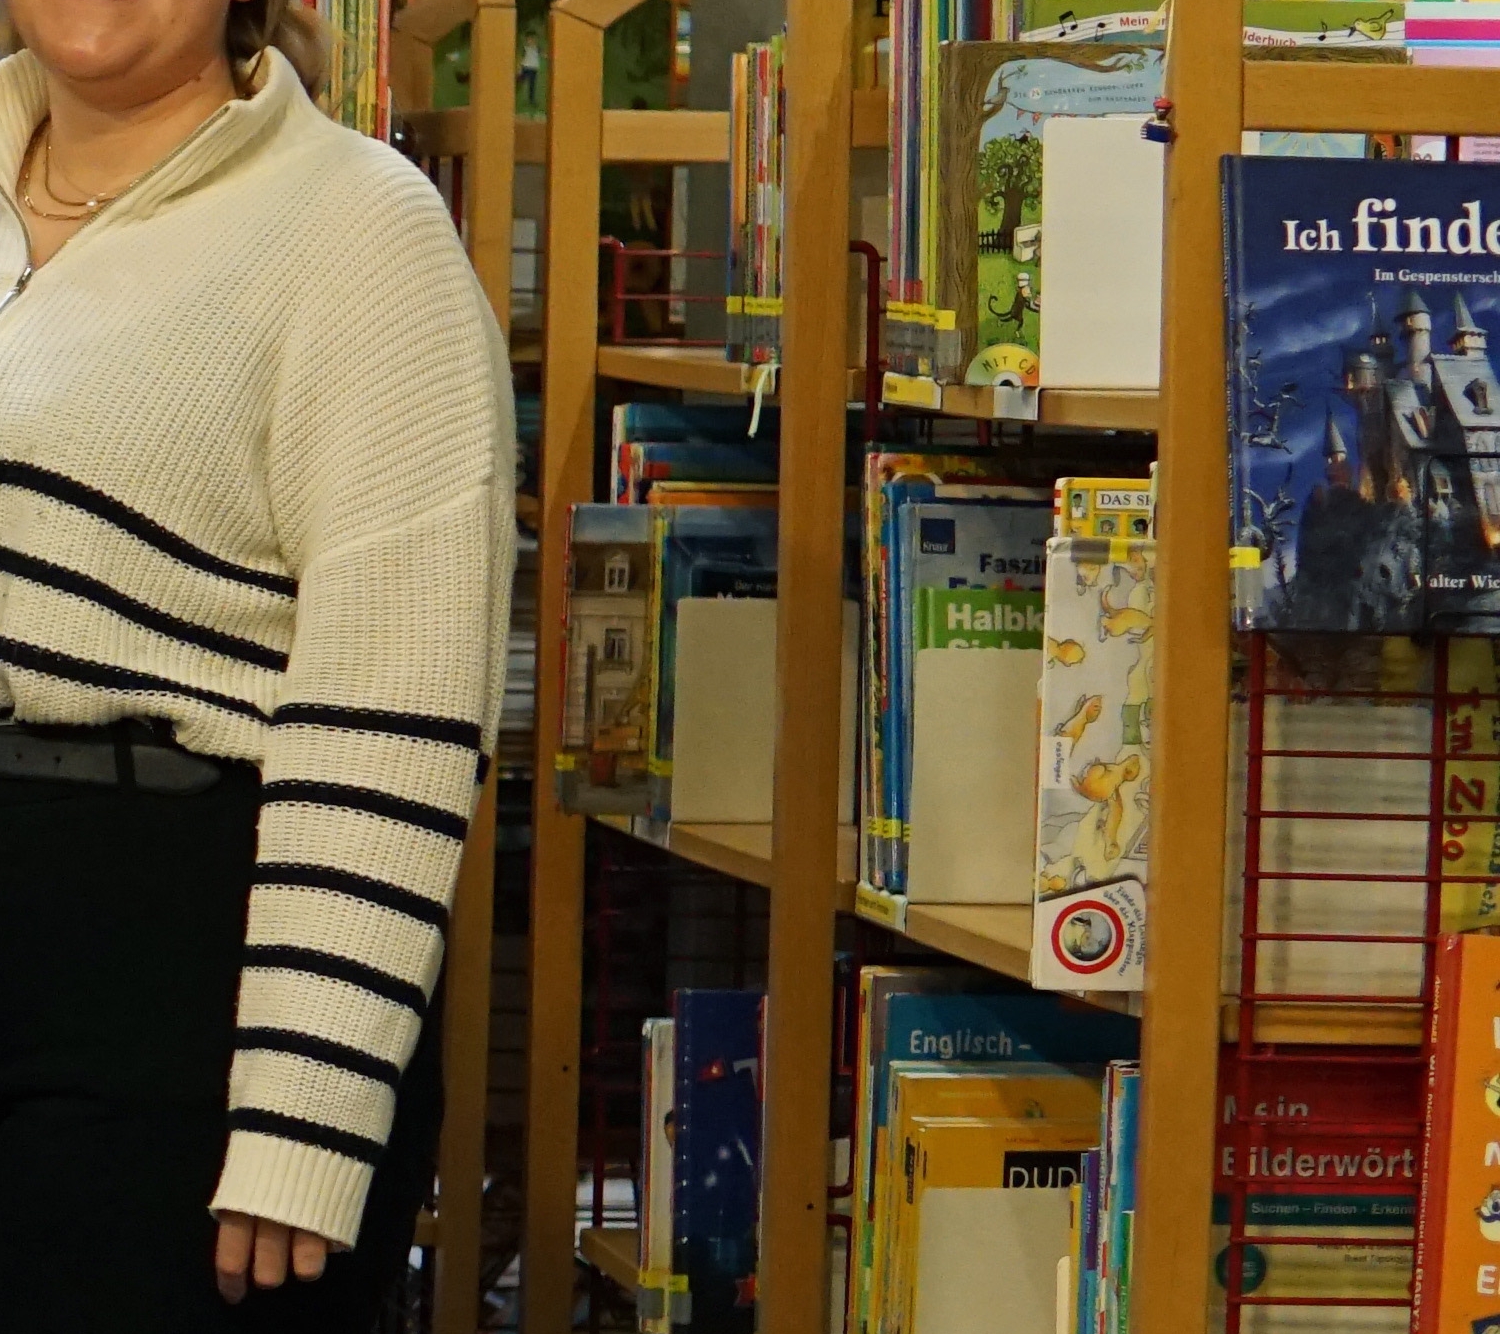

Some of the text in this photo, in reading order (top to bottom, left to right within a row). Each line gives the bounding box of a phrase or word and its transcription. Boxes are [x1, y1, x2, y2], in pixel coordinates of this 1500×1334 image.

[1283, 219, 1344, 252] Ich
[1100, 493, 1132, 506] DAS
[909, 1028, 1014, 1060] Englisch
